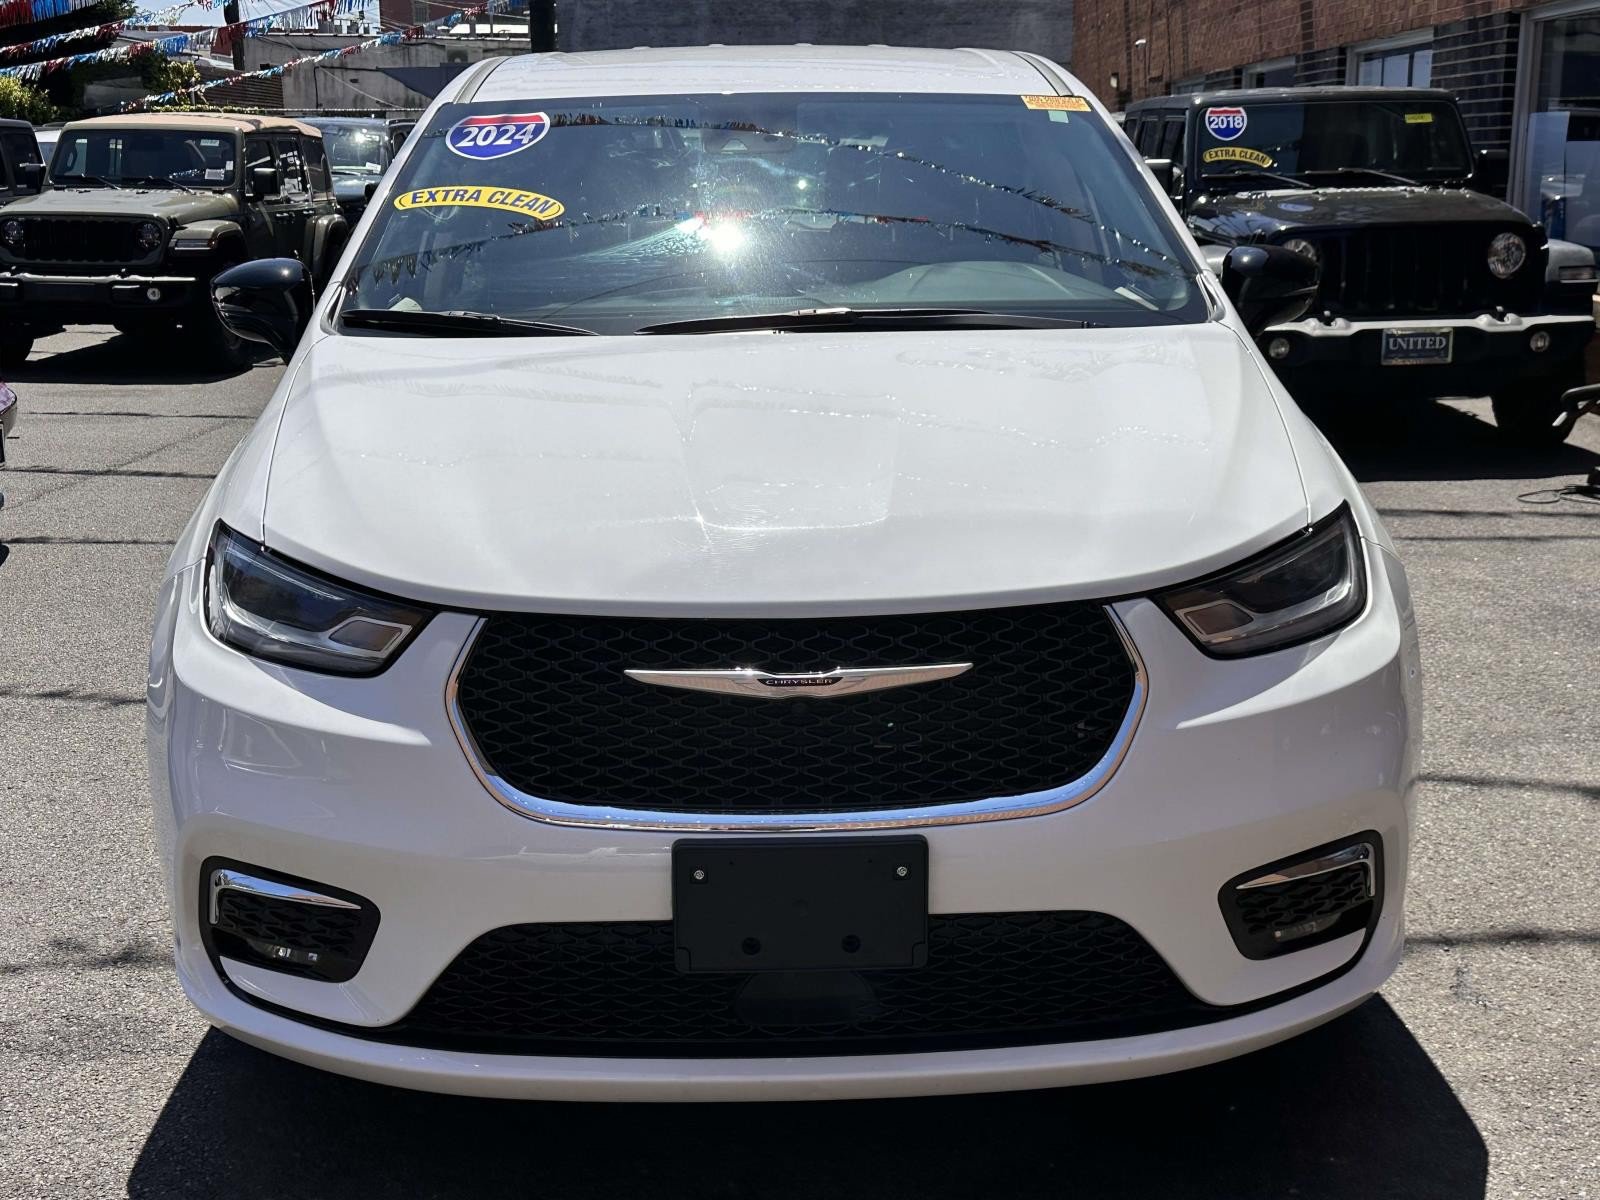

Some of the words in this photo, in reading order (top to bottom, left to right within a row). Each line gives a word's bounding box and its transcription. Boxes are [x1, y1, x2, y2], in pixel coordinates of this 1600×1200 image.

[1209, 116, 1243, 129] 2018
[455, 124, 535, 147] 2024
[1208, 150, 1237, 159] EXTRA
[1239, 150, 1268, 164] CLEAN
[411, 189, 482, 205] EXTRA
[487, 190, 557, 214] CLEAN
[1388, 336, 1447, 350] UNITED
